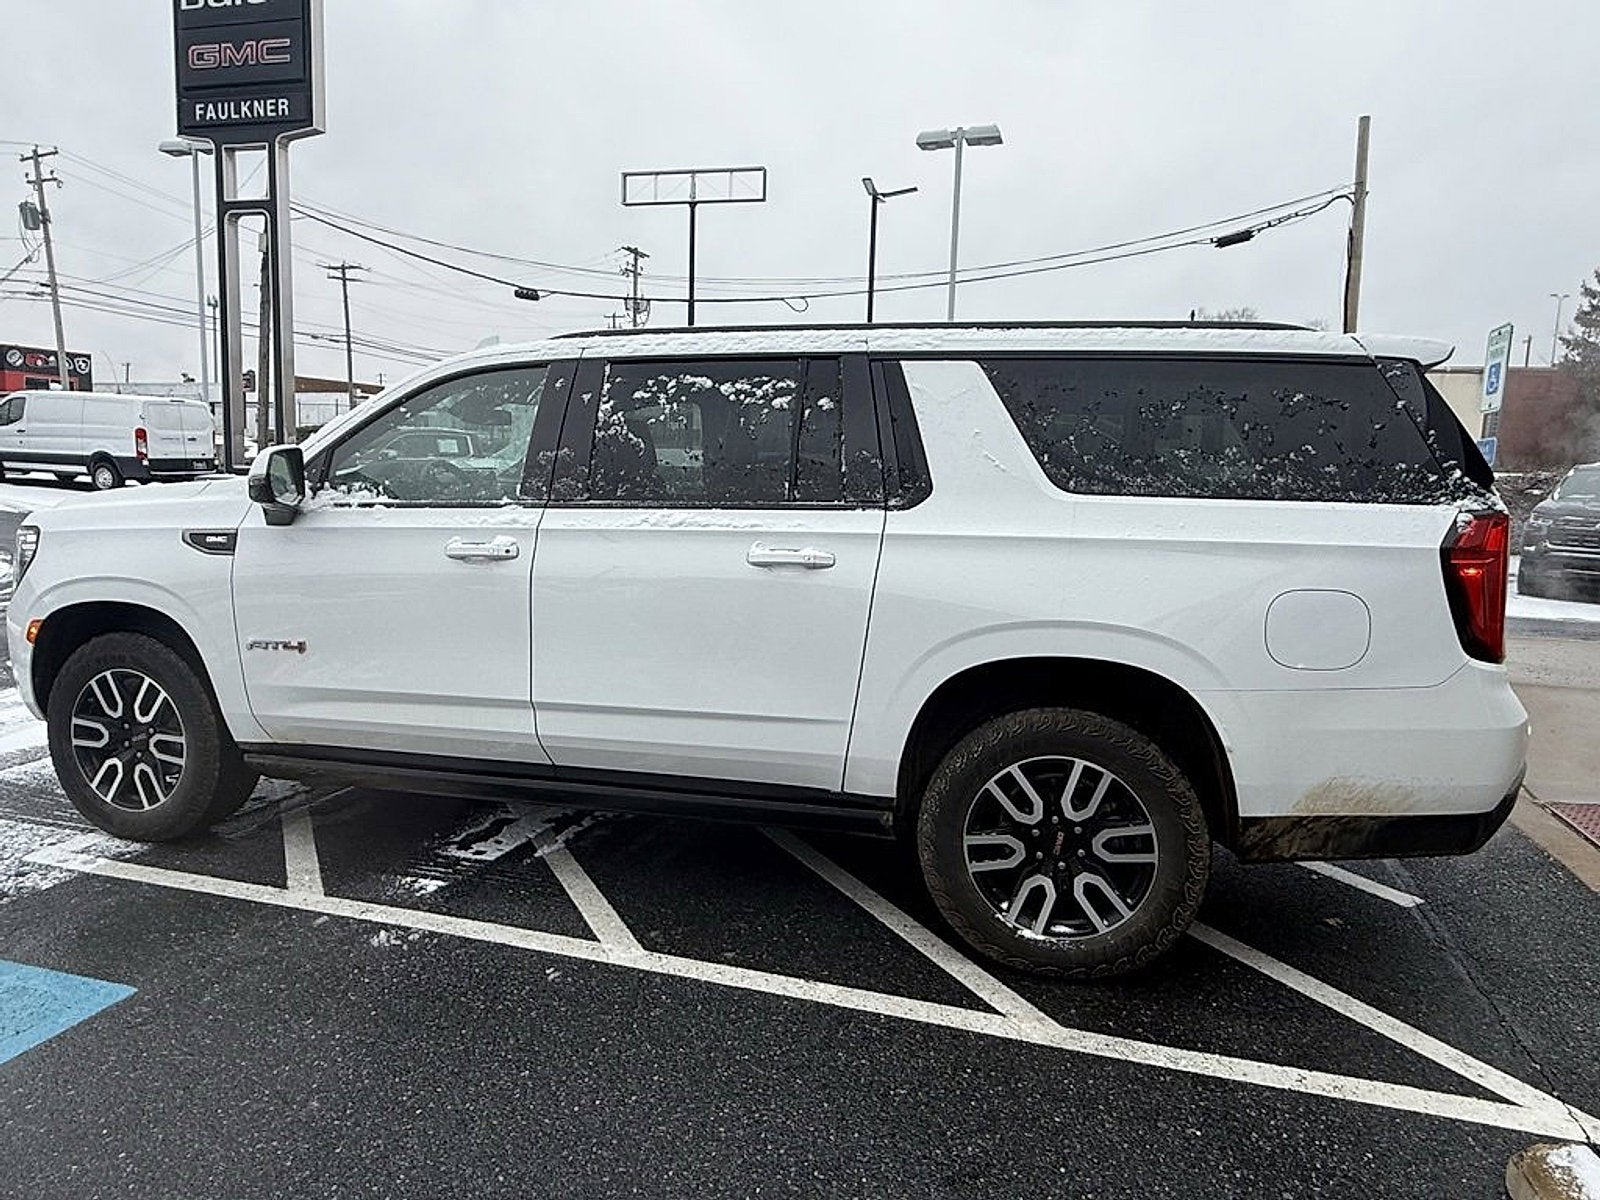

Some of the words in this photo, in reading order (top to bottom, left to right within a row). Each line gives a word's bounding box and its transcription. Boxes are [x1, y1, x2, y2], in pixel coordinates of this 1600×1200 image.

[188, 38, 290, 69] GMC
[195, 98, 290, 121] FAULKNER
[206, 535, 228, 543] GMC
